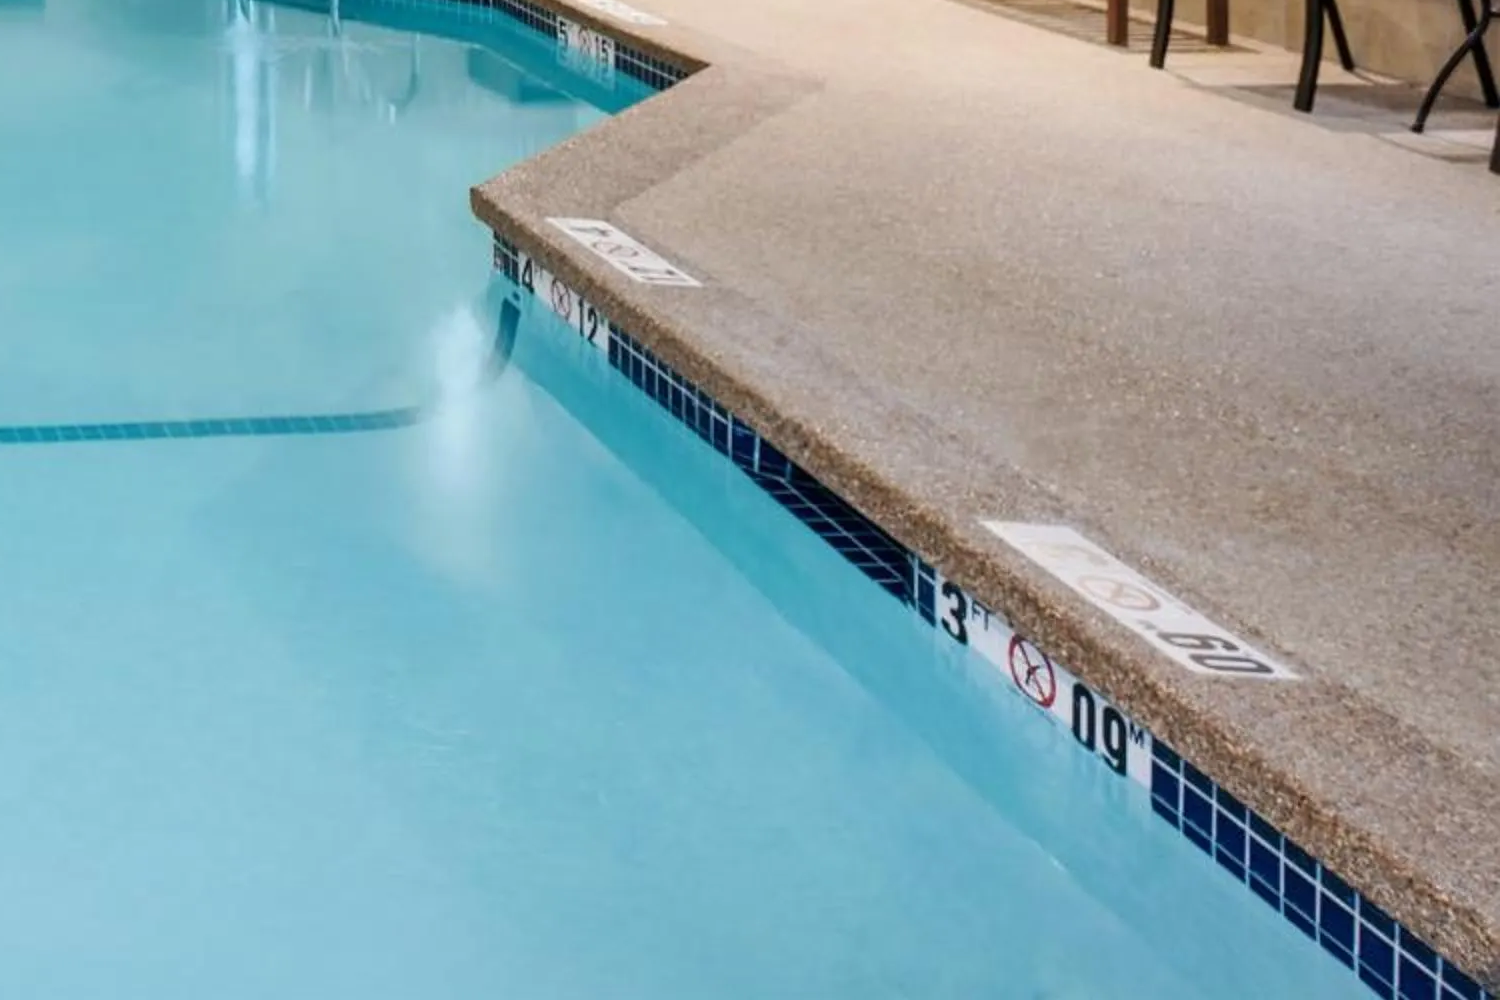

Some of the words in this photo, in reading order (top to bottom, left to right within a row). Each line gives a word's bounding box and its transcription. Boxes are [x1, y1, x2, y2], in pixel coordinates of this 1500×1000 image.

[579, 296, 597, 348] 12
[942, 581, 968, 646] 3
[1072, 682, 1127, 777] 09
